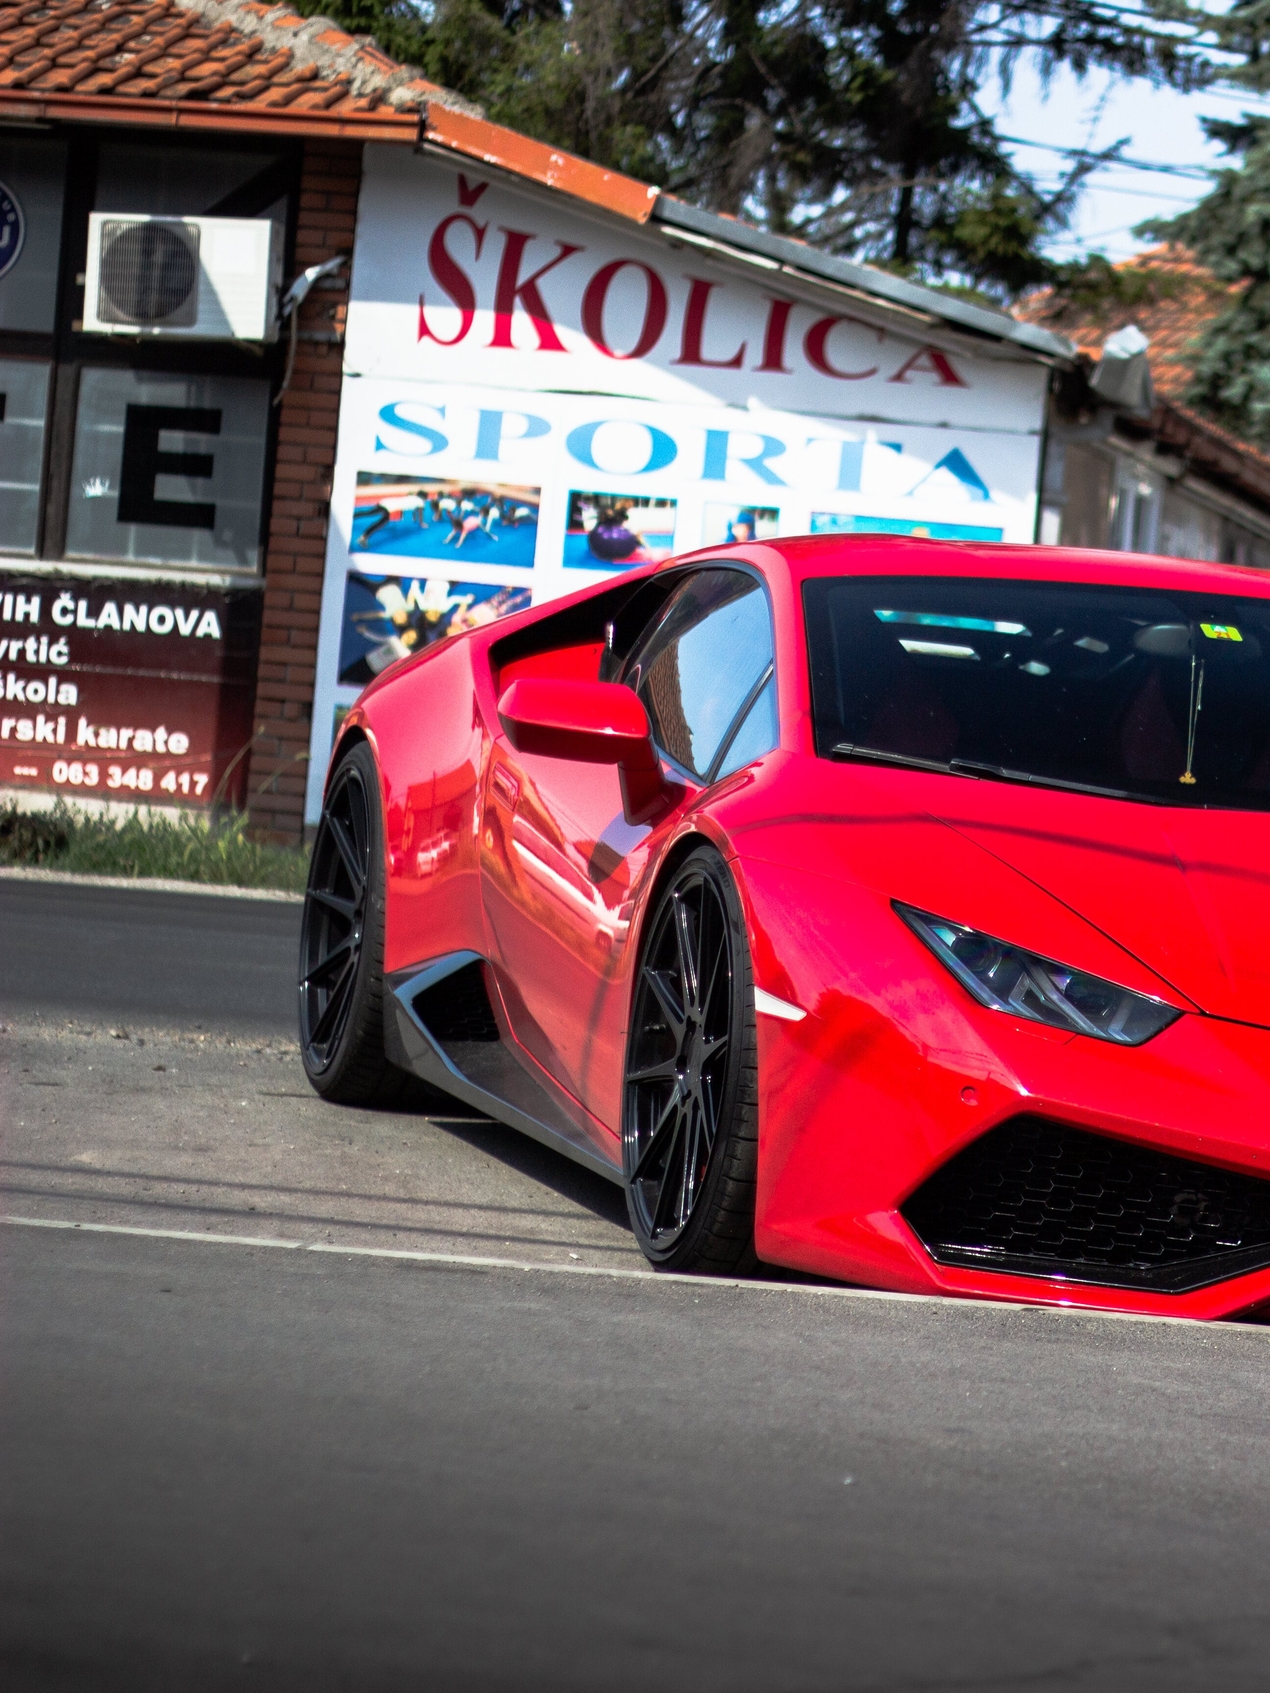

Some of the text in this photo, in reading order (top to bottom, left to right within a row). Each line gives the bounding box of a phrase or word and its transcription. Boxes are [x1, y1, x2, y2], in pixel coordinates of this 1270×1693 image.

[417, 173, 971, 389] ŠKOLICA
[374, 401, 992, 502] SPORTA
[52, 592, 222, 639] ČLANOVA
[0, 672, 78, 705] kola
[76, 716, 190, 755] karate
[52, 760, 100, 787] 063
[160, 770, 209, 796] 417
